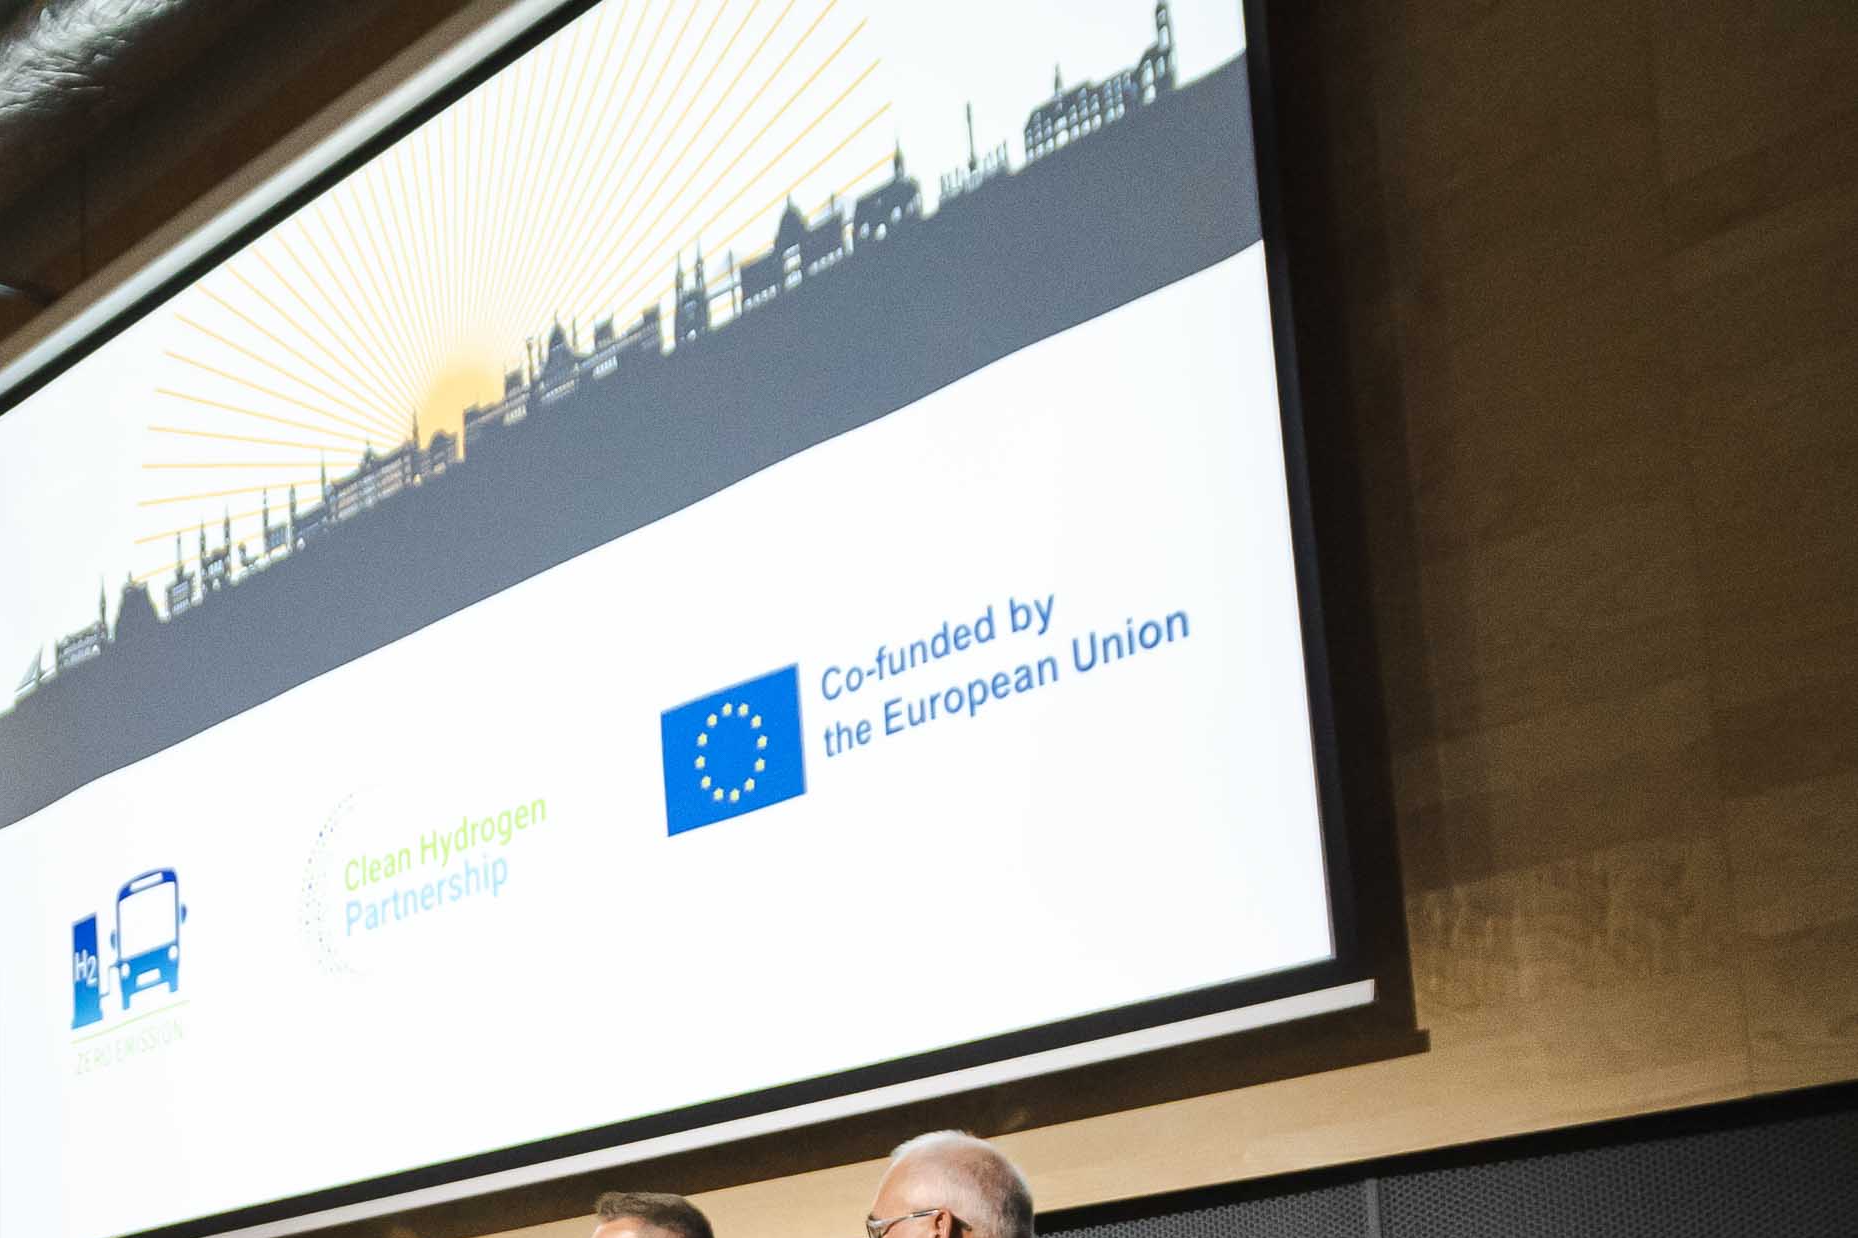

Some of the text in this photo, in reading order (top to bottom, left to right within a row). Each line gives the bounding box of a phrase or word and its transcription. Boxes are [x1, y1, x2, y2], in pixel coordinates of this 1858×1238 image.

[820, 594, 1055, 701] Co-funded by
[823, 608, 1191, 758] the European Union
[345, 797, 547, 892] Clean Hydrogen
[345, 853, 508, 937] Partnership
